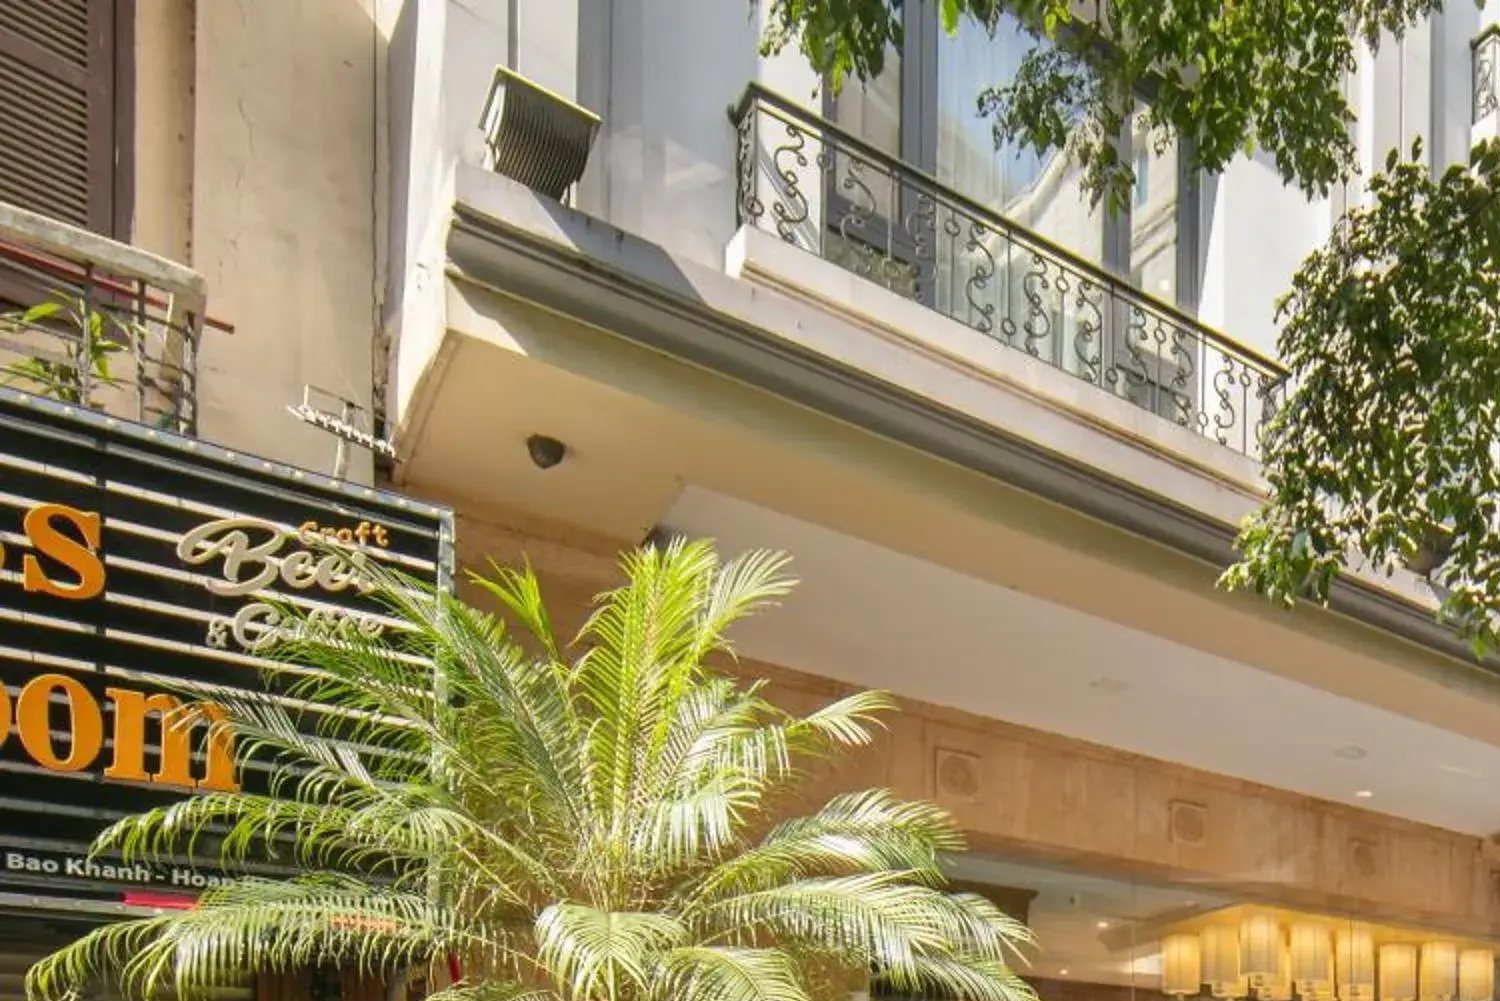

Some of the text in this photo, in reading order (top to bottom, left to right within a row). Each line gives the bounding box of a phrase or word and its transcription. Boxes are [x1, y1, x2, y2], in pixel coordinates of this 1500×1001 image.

[299, 521, 389, 548] Craft
[0, 503, 106, 600] S
[206, 618, 228, 648] &
[0, 673, 240, 792] om
[6, 852, 60, 874] Bao
[65, 857, 151, 883] Khanh
